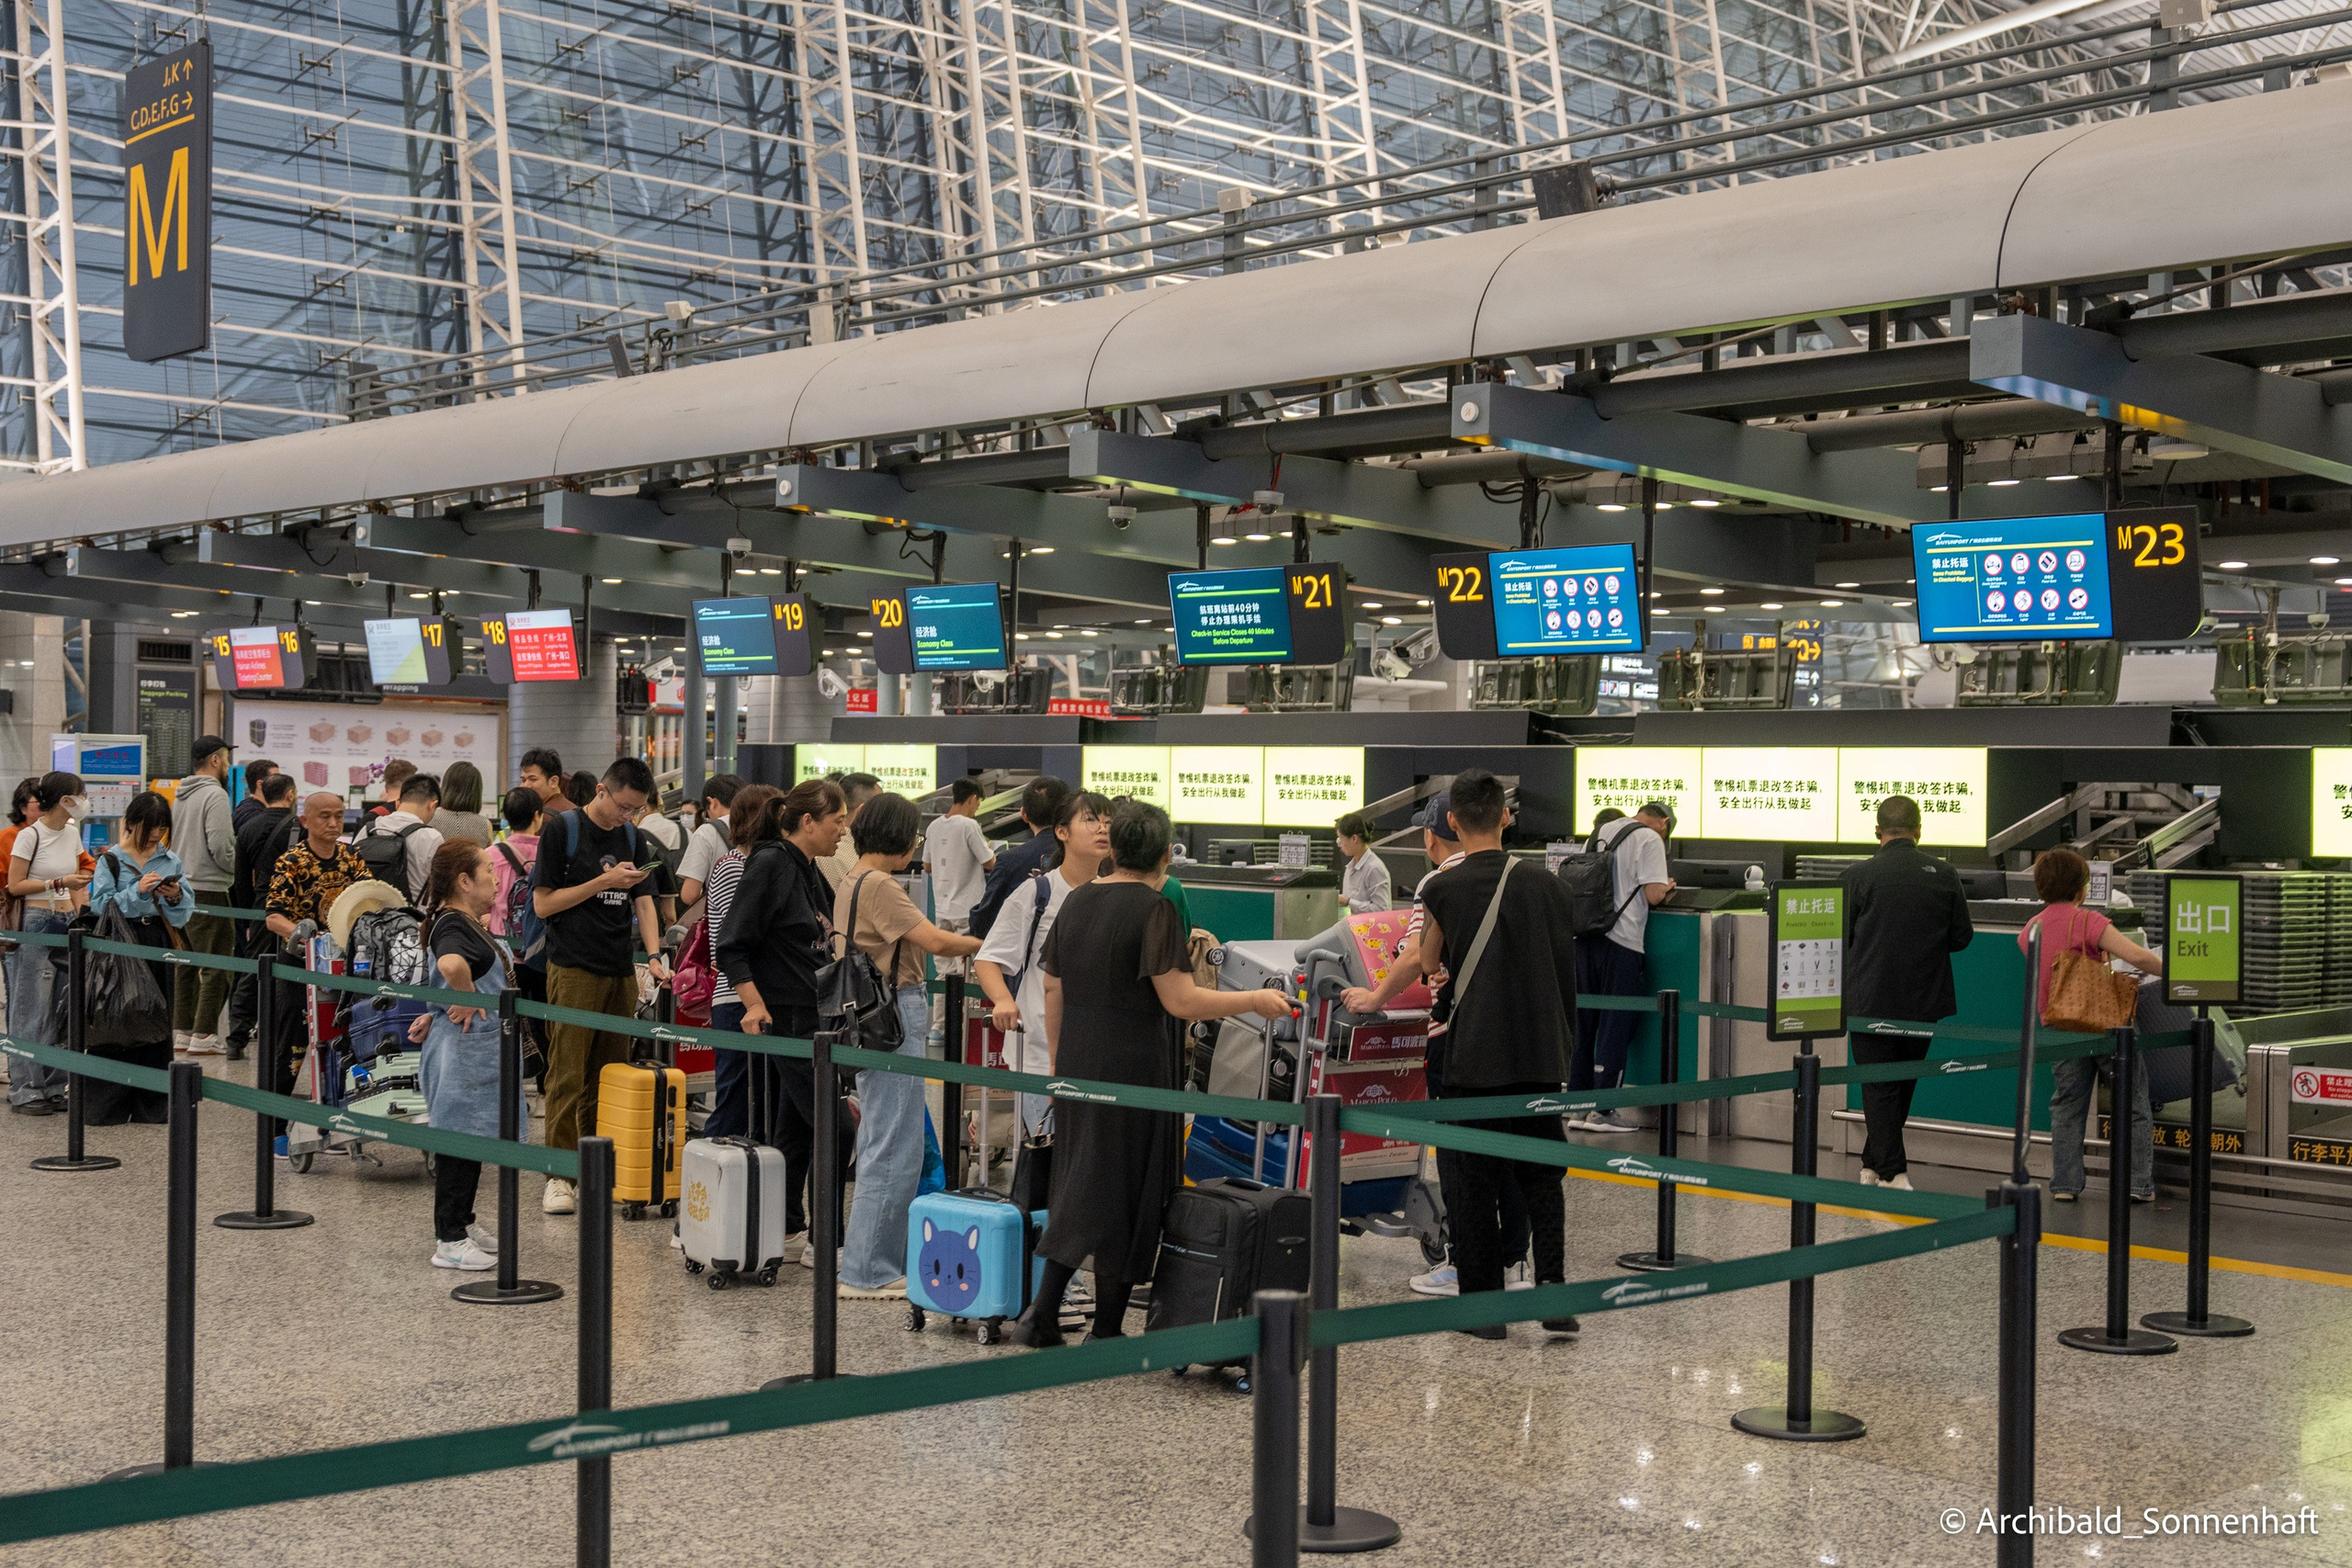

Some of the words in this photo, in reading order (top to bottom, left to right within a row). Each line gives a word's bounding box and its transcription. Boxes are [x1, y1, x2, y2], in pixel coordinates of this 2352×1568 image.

[163, 61, 180, 87] J,K
[130, 94, 179, 130] C,D,E,F,G
[129, 146, 189, 287] M
[2118, 524, 2185, 567] M23
[1932, 557, 1969, 569] 禁止托运
[1292, 573, 1332, 608] M21
[1437, 567, 1484, 602] M22
[1504, 581, 1532, 592] 禁止托运
[775, 603, 804, 631] M19
[872, 598, 903, 627] M20
[1199, 603, 1260, 615] 航班离站前40分钟
[1201, 614, 1261, 626] 停止办理乘机手续
[422, 623, 442, 648] M17
[482, 621, 506, 645] M18
[915, 626, 938, 638] 经济舱
[1229, 637, 1253, 646] Departure
[704, 649, 723, 657] Economy
[723, 647, 735, 655] Class
[917, 640, 940, 649] Economy
[940, 639, 954, 648] Class
[2334, 784, 2352, 799] 警
[596, 891, 628, 900] ATTACK
[1786, 897, 1835, 915] 禁止托运
[2177, 900, 2230, 934] 出口
[2177, 941, 2209, 957] Exit
[2175, 1129, 2242, 1154] 轮朝外
